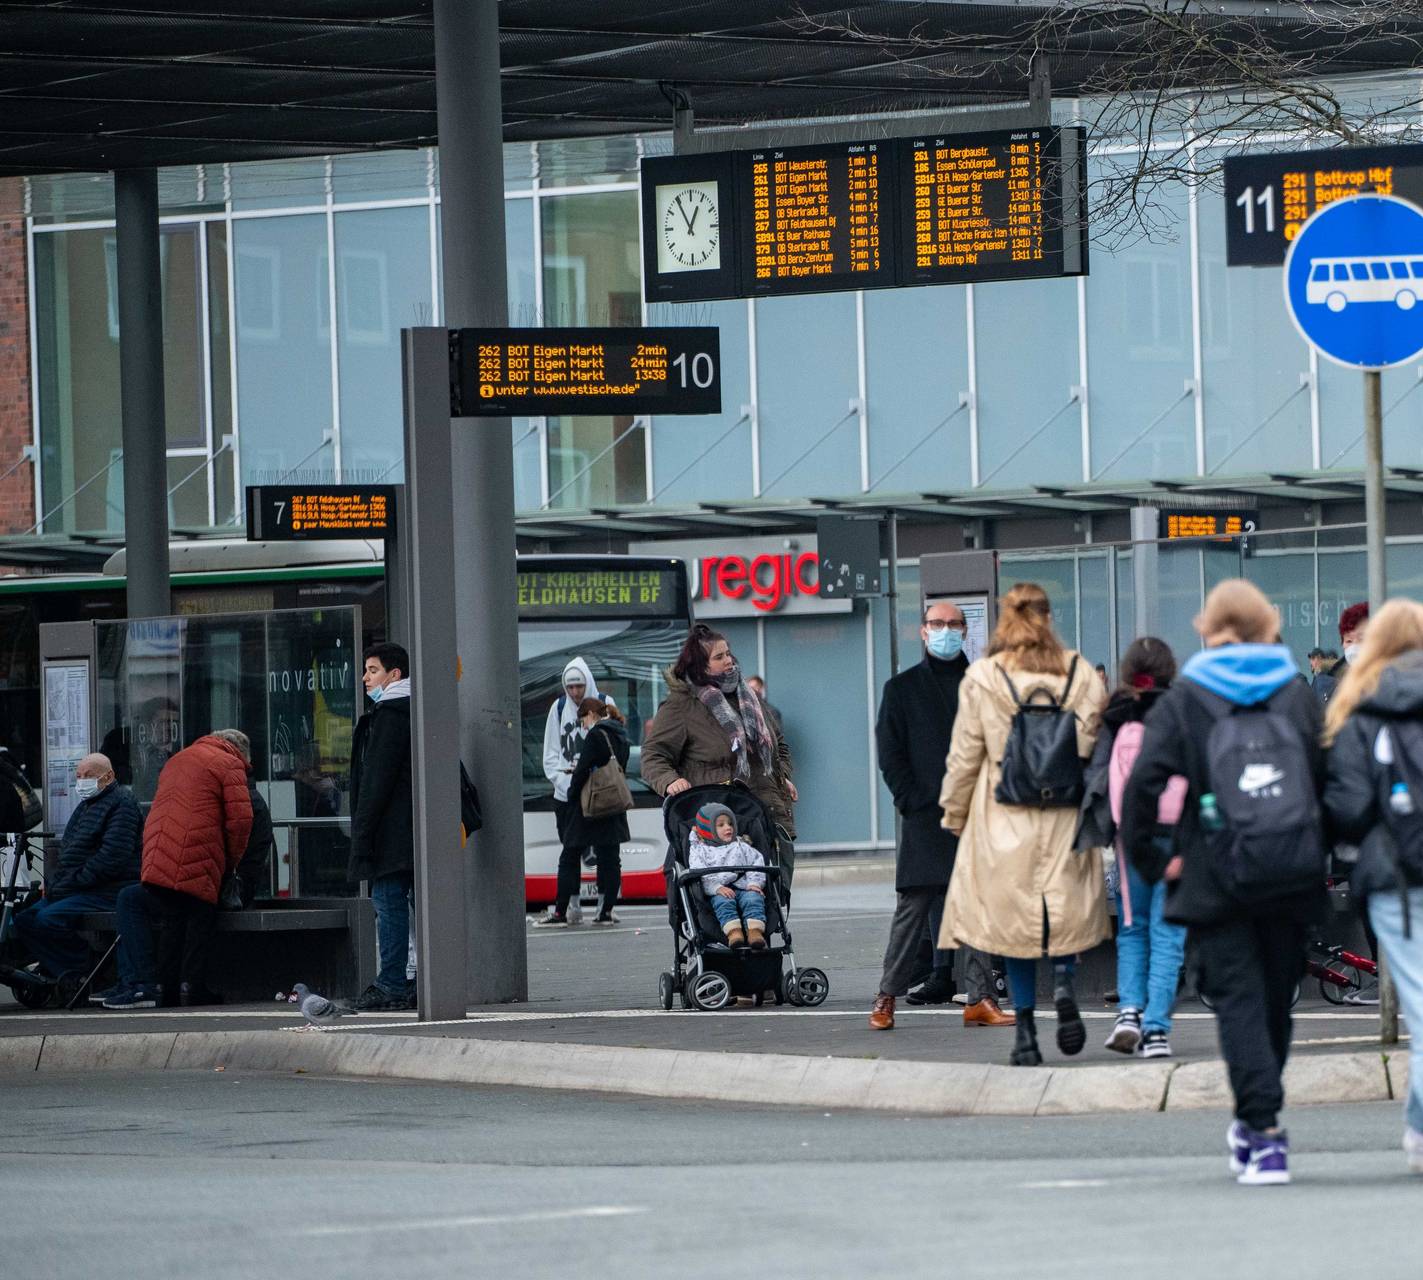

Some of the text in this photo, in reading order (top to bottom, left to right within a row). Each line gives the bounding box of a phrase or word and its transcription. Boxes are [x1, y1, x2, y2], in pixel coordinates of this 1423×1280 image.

[914, 150, 928, 161] 261
[936, 149, 948, 159] BOT
[774, 161, 786, 172] BOT
[936, 160, 956, 171] Essen
[754, 174, 768, 185] 261
[775, 173, 787, 183] BOT
[789, 172, 806, 184] Eigen
[808, 170, 828, 181] Markt
[1010, 167, 1028, 178] 13:06
[1283, 172, 1306, 188] 291
[1315, 170, 1365, 186] Bottrop
[1368, 166, 1392, 184] Hbf
[754, 186, 768, 196] 262
[776, 185, 788, 195] BOT
[790, 183, 807, 196] Eigen
[809, 182, 828, 192] Markt
[947, 183, 969, 194] Buerer
[776, 196, 795, 206] Essen
[796, 194, 816, 207] Boyer
[947, 195, 970, 205] Buerer
[1283, 188, 1307, 204] 291
[948, 206, 970, 217] Buerer
[1236, 184, 1274, 234] 11
[1284, 205, 1307, 220] 291
[755, 221, 769, 231] 267
[777, 219, 788, 230] BOT
[938, 220, 950, 230] BOT
[786, 230, 801, 241] Buer
[804, 228, 831, 239] Rathaus
[938, 231, 950, 241] BOT
[952, 230, 973, 240] Zeche
[974, 229, 992, 239] Franz
[756, 244, 770, 254] 979
[788, 252, 833, 264] Bero-Zentrum
[917, 256, 931, 266] 291
[939, 254, 964, 267] Bottrop
[966, 253, 977, 265] Hbf
[778, 266, 790, 276] BOT
[792, 265, 811, 277] Boyer
[812, 263, 832, 274] Markt
[479, 346, 500, 356] 262
[508, 346, 529, 356] BOT
[534, 346, 566, 358] Eigen
[570, 345, 604, 356] Markt
[479, 358, 500, 369] 262
[508, 358, 529, 369] BOT
[534, 358, 566, 370] Eigen
[570, 358, 605, 368] Markt
[672, 352, 714, 388] 10
[480, 370, 667, 383] 262 BOT Eigen Markt 13:38
[496, 386, 529, 396] unter
[274, 502, 285, 524] 7
[518, 587, 661, 606] ELDHAUSEN BF
